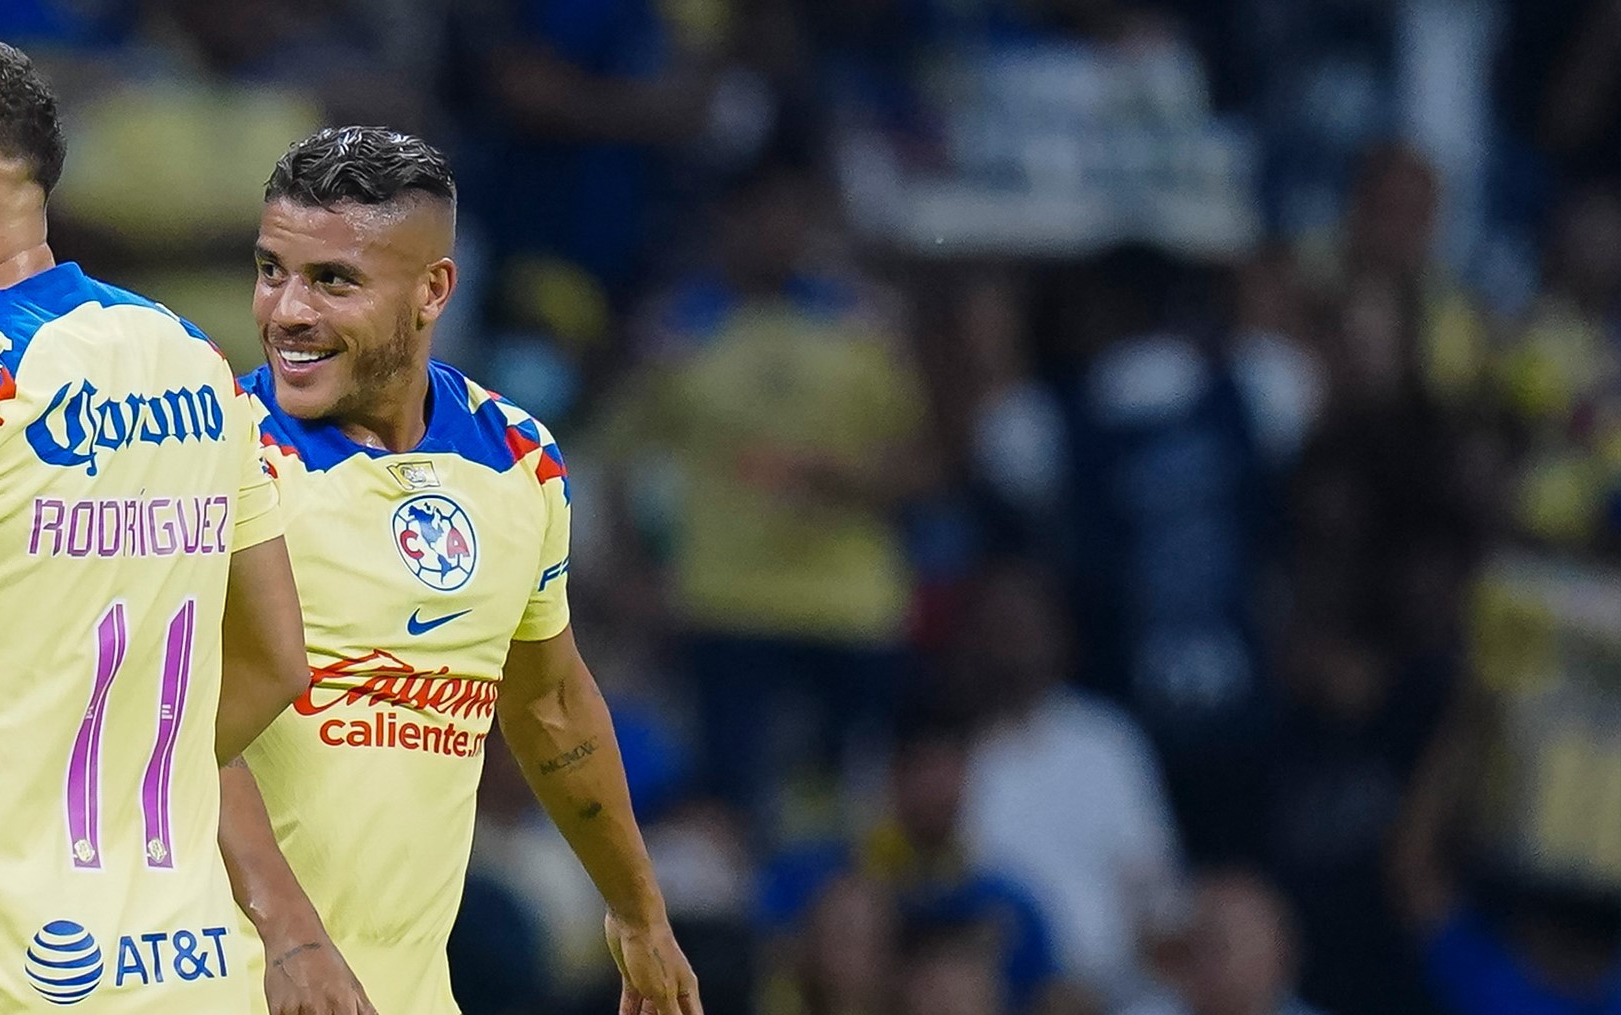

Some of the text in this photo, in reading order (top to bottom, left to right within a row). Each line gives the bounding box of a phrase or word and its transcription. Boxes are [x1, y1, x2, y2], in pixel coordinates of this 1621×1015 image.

[25, 378, 225, 477] Corona
[28, 488, 229, 557] RODRÍGUEZ
[66, 599, 195, 869] 11
[115, 926, 230, 987] AT&T
